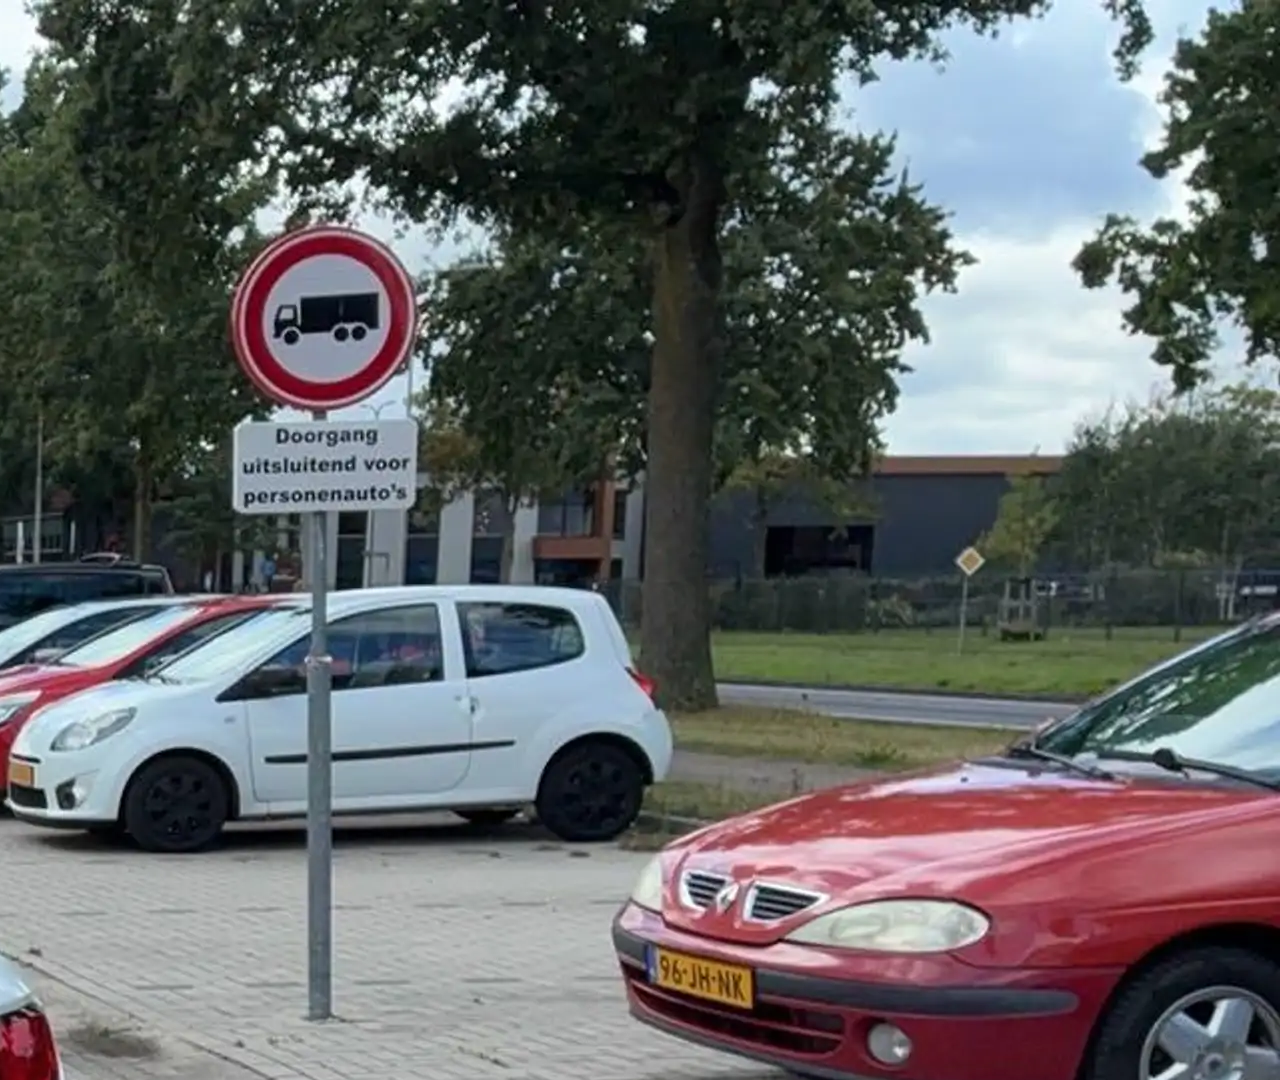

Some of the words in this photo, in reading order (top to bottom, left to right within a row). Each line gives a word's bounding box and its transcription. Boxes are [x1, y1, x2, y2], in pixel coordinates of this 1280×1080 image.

[275, 428, 379, 447] Doorgang
[243, 456, 357, 475] uitsluitend
[364, 457, 411, 471] voor
[243, 483, 408, 508] personenauto's
[660, 955, 747, 1003] 96-JH-NK
